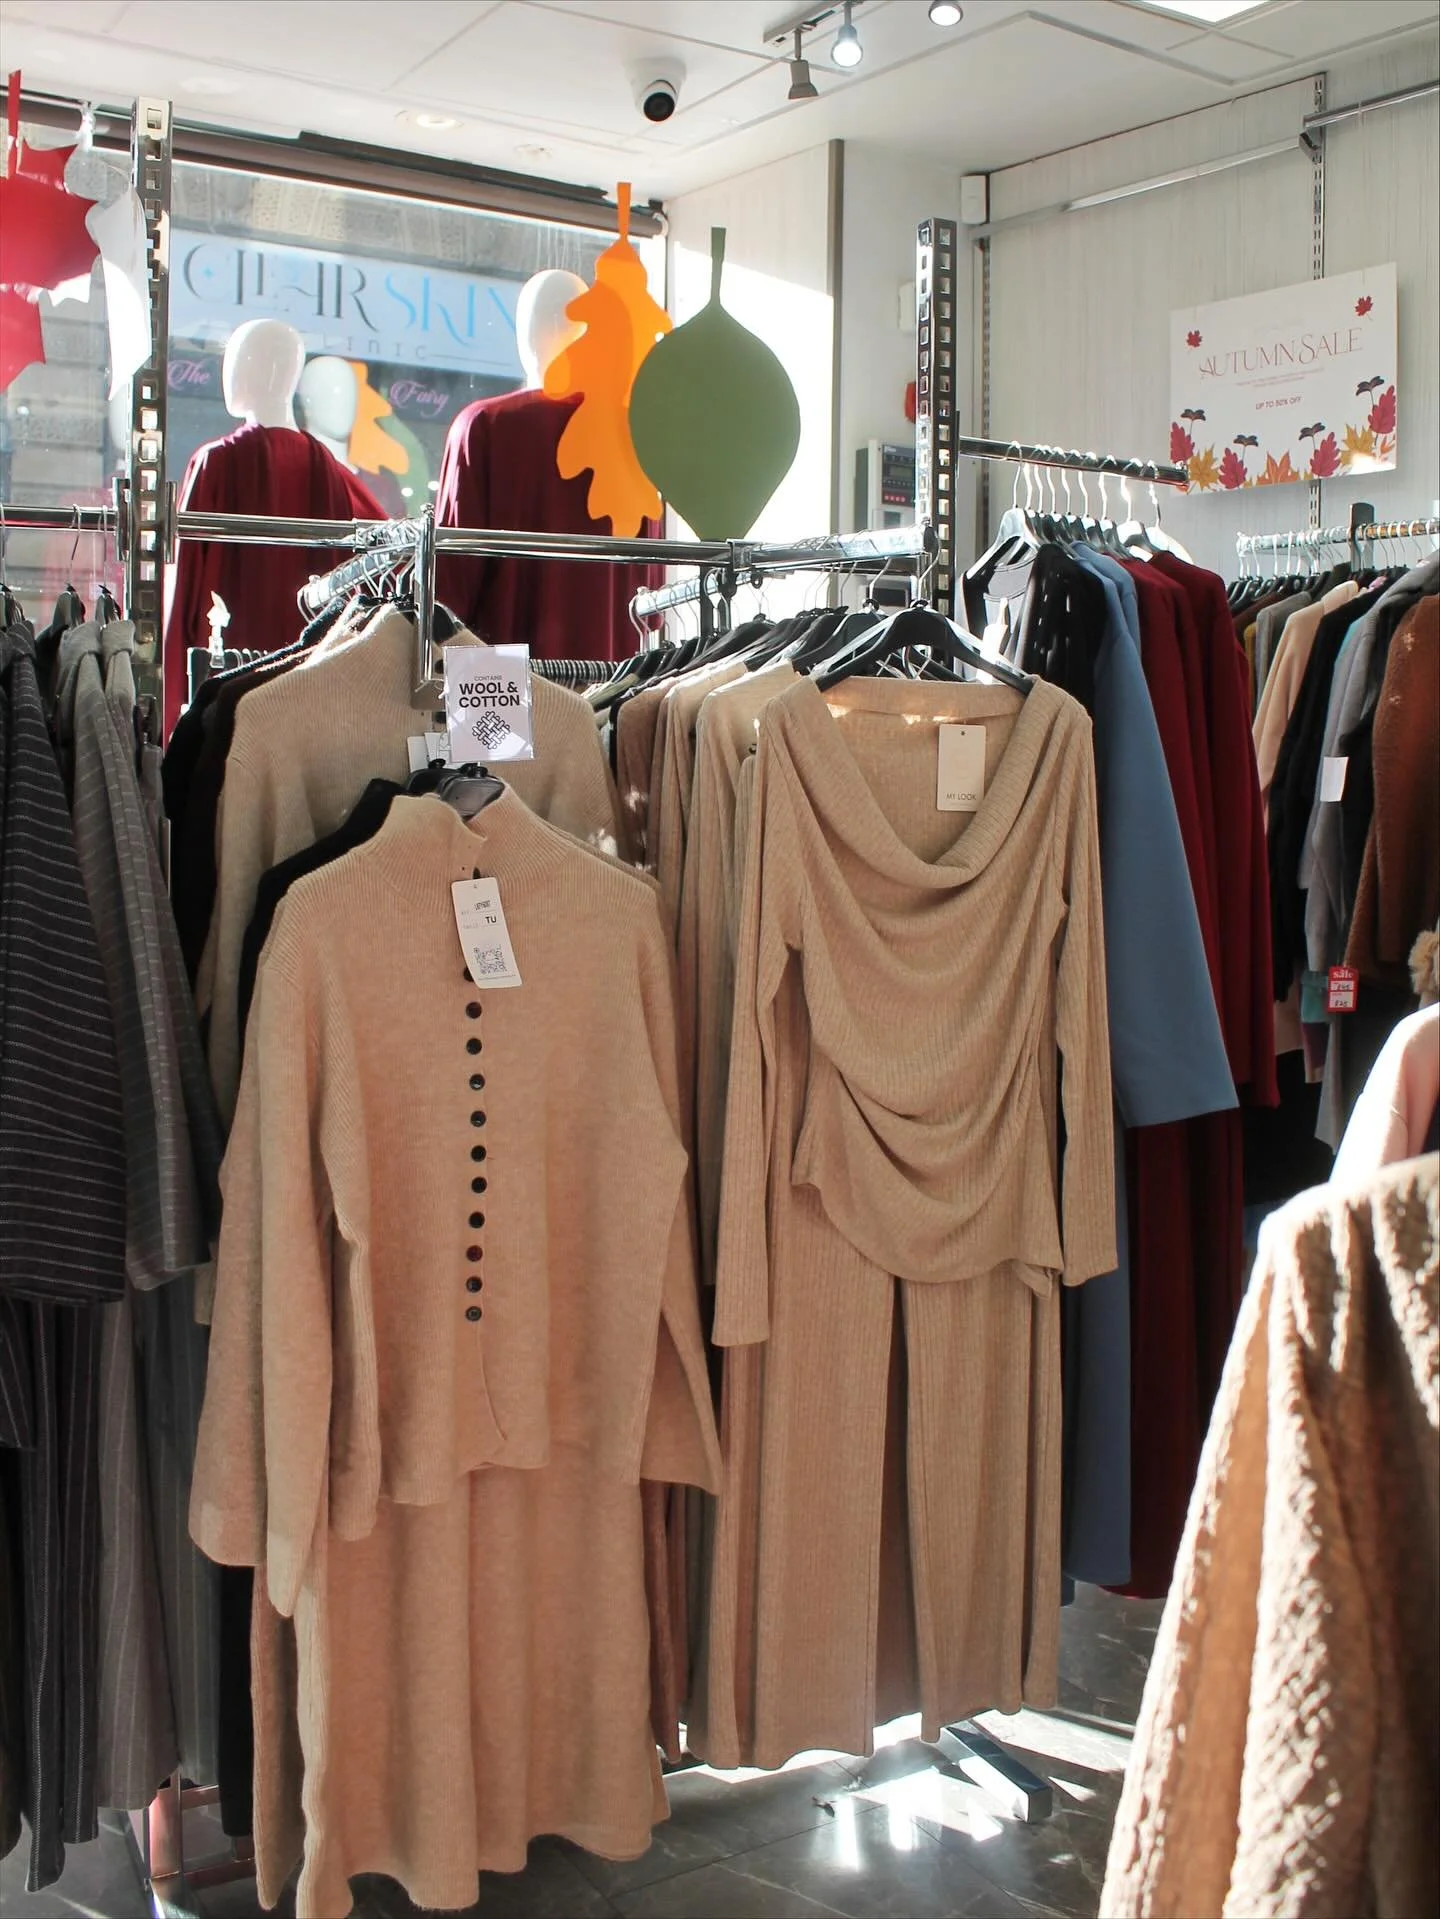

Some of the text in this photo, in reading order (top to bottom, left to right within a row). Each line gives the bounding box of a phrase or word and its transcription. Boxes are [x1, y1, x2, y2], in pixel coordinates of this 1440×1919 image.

[1199, 339, 1295, 379] AUTUMN
[1298, 327, 1363, 365] SALE
[391, 379, 449, 419] Fairy
[459, 681, 518, 695] WOOL &
[459, 695, 520, 708] COTTON
[485, 915, 497, 923] TU
